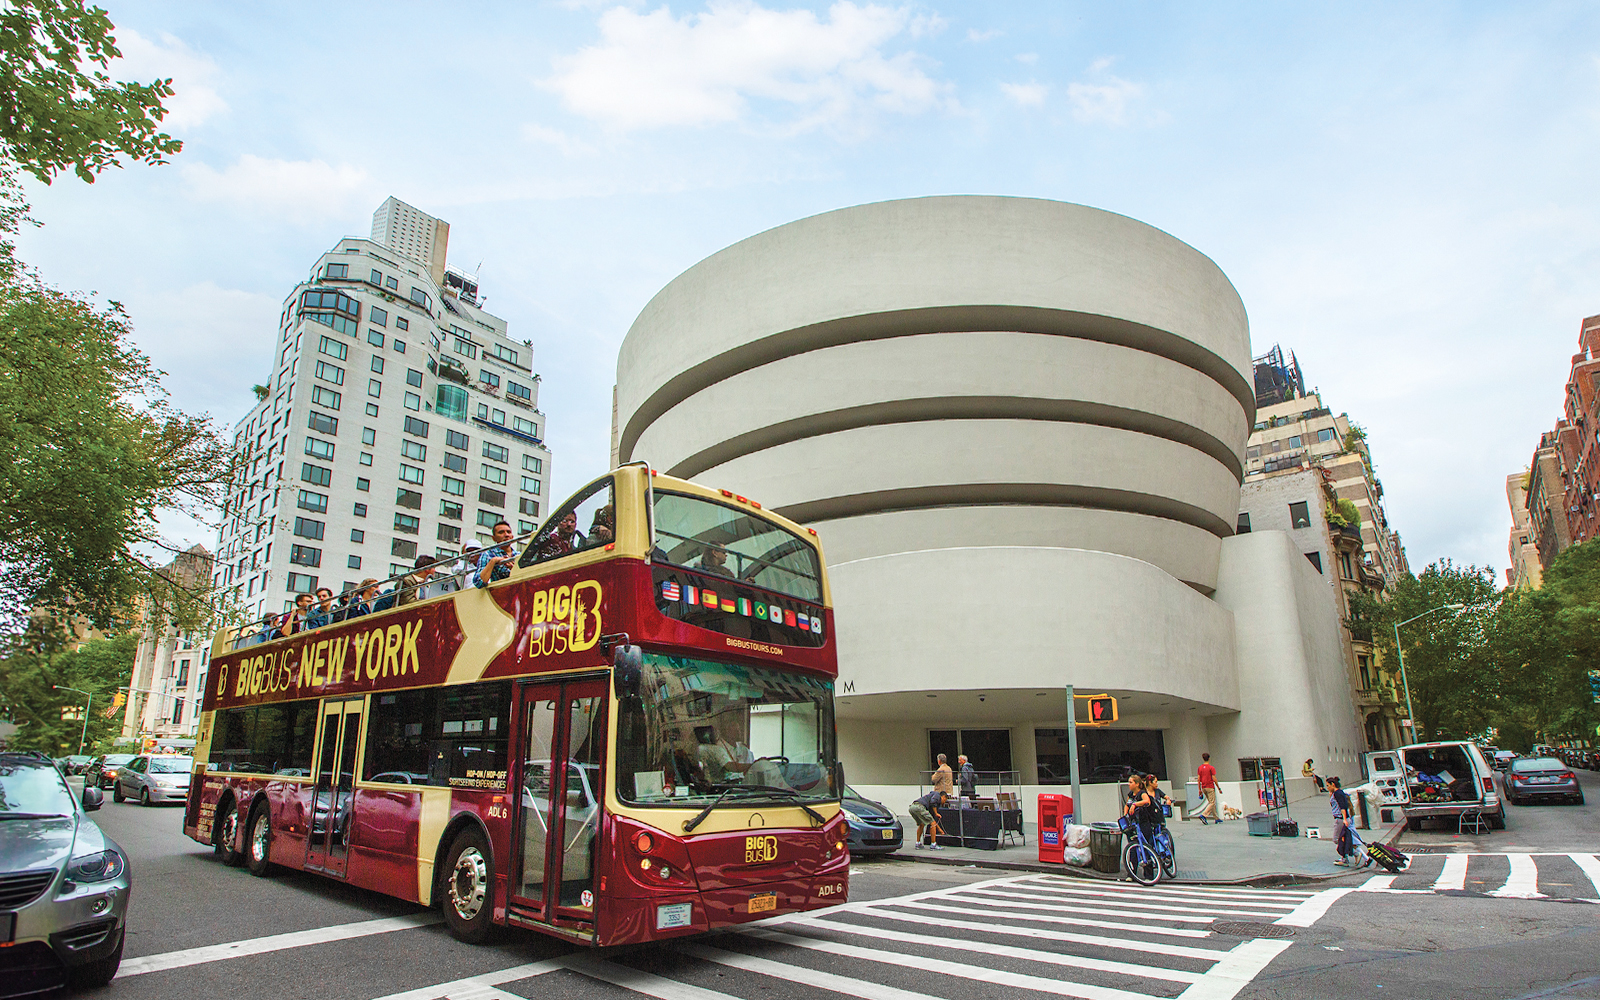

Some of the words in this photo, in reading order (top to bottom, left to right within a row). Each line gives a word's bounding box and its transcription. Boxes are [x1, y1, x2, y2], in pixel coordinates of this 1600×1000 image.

[532, 585, 570, 625] BIG
[529, 622, 567, 658] BUS
[726, 637, 784, 656] BIGBUSTOURS.COM
[297, 635, 350, 688] NEW
[354, 619, 423, 681] YORK
[475, 779, 507, 789] EXPERIENCES
[488, 806, 501, 818] ADL
[502, 808, 508, 819] 6
[745, 837, 764, 850] BIG
[745, 849, 764, 863] BUS
[818, 885, 836, 897] ADL
[836, 883, 842, 893] 6
